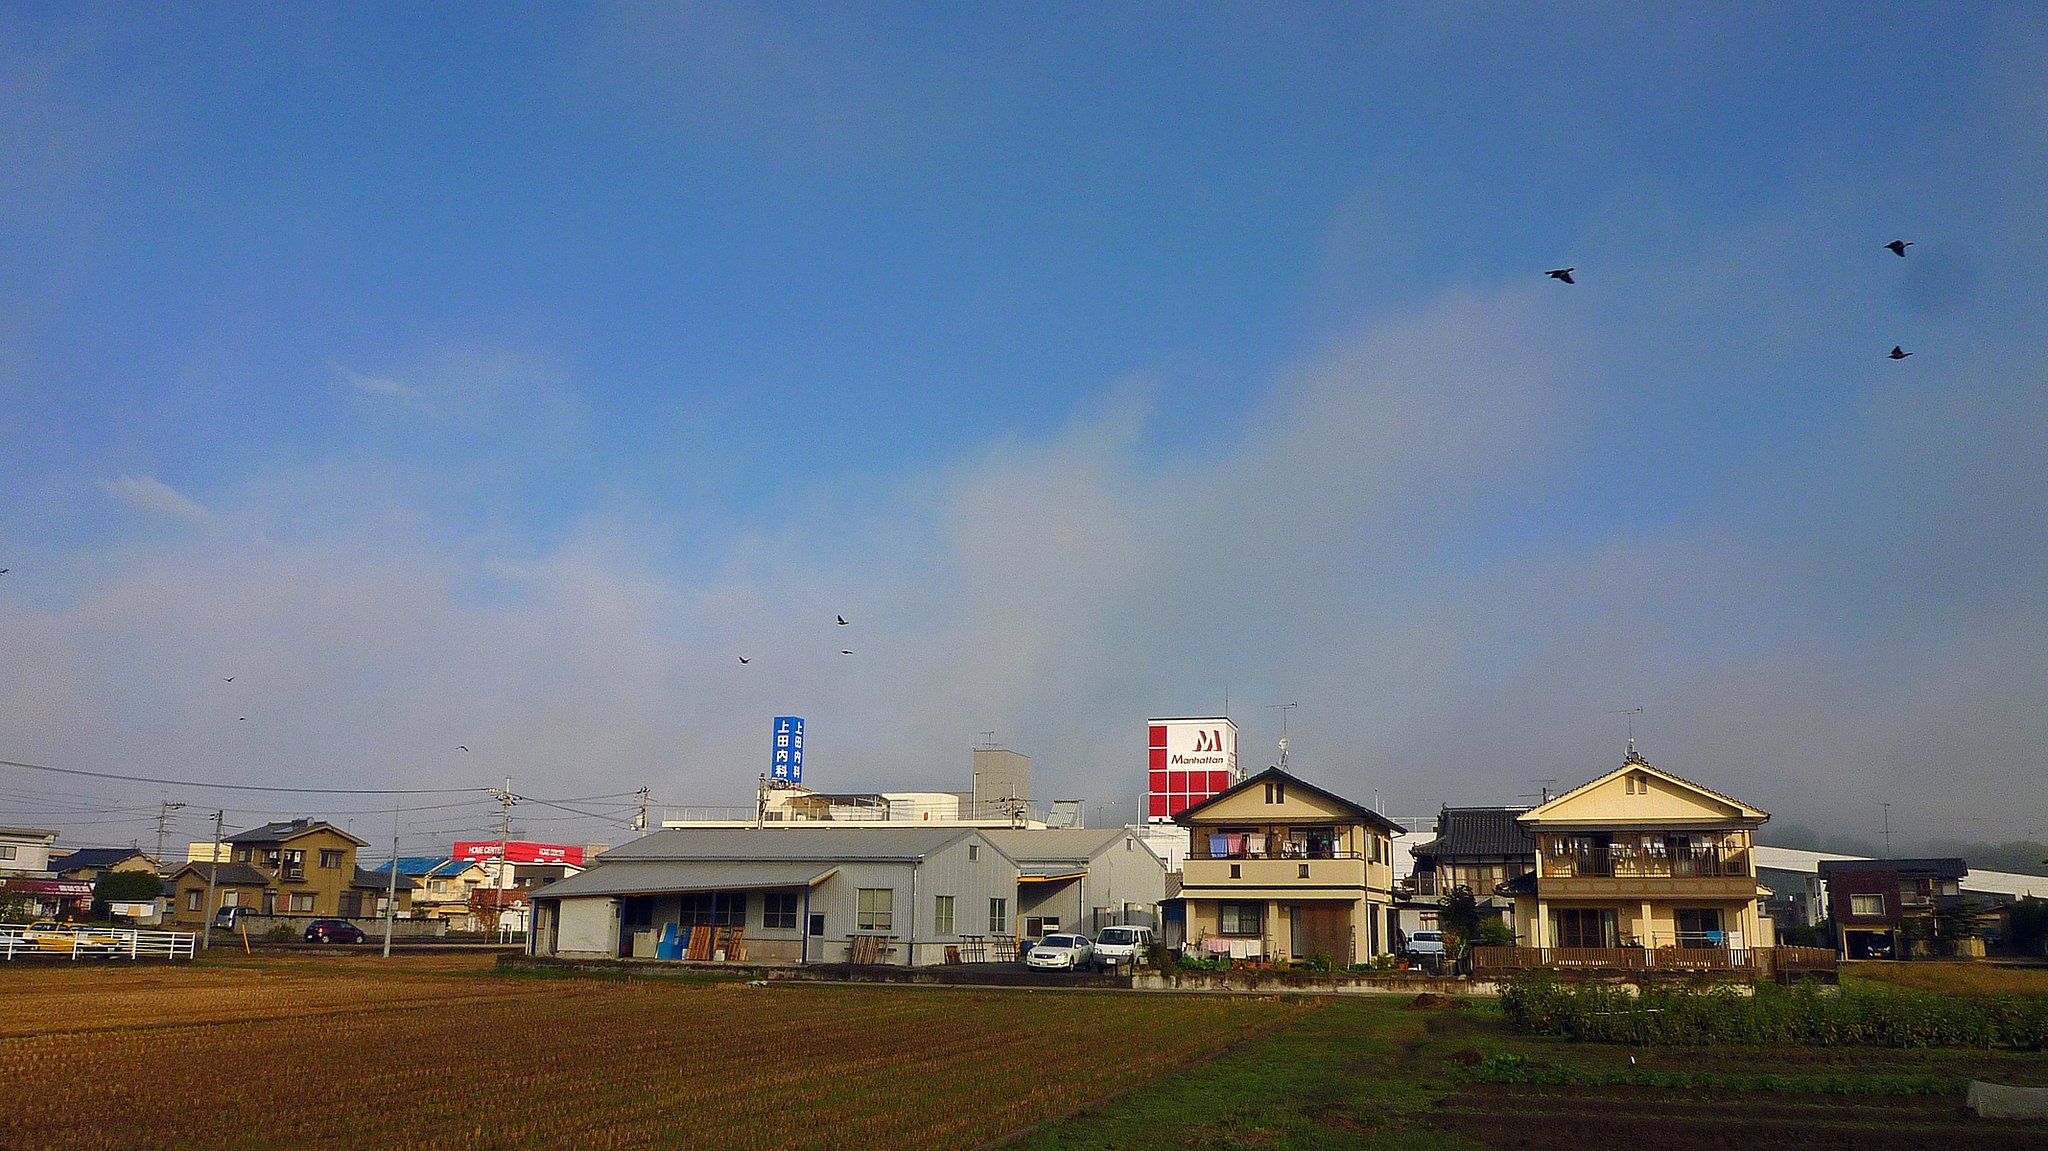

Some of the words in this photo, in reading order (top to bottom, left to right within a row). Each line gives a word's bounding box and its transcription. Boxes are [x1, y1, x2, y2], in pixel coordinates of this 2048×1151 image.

[775, 720, 790, 778] 上田内科
[793, 721, 803, 779] 上田内科
[1192, 729, 1222, 752] M
[1171, 754, 1224, 765] Manhattan
[468, 846, 484, 854] HOME
[484, 846, 502, 854] CENTE
